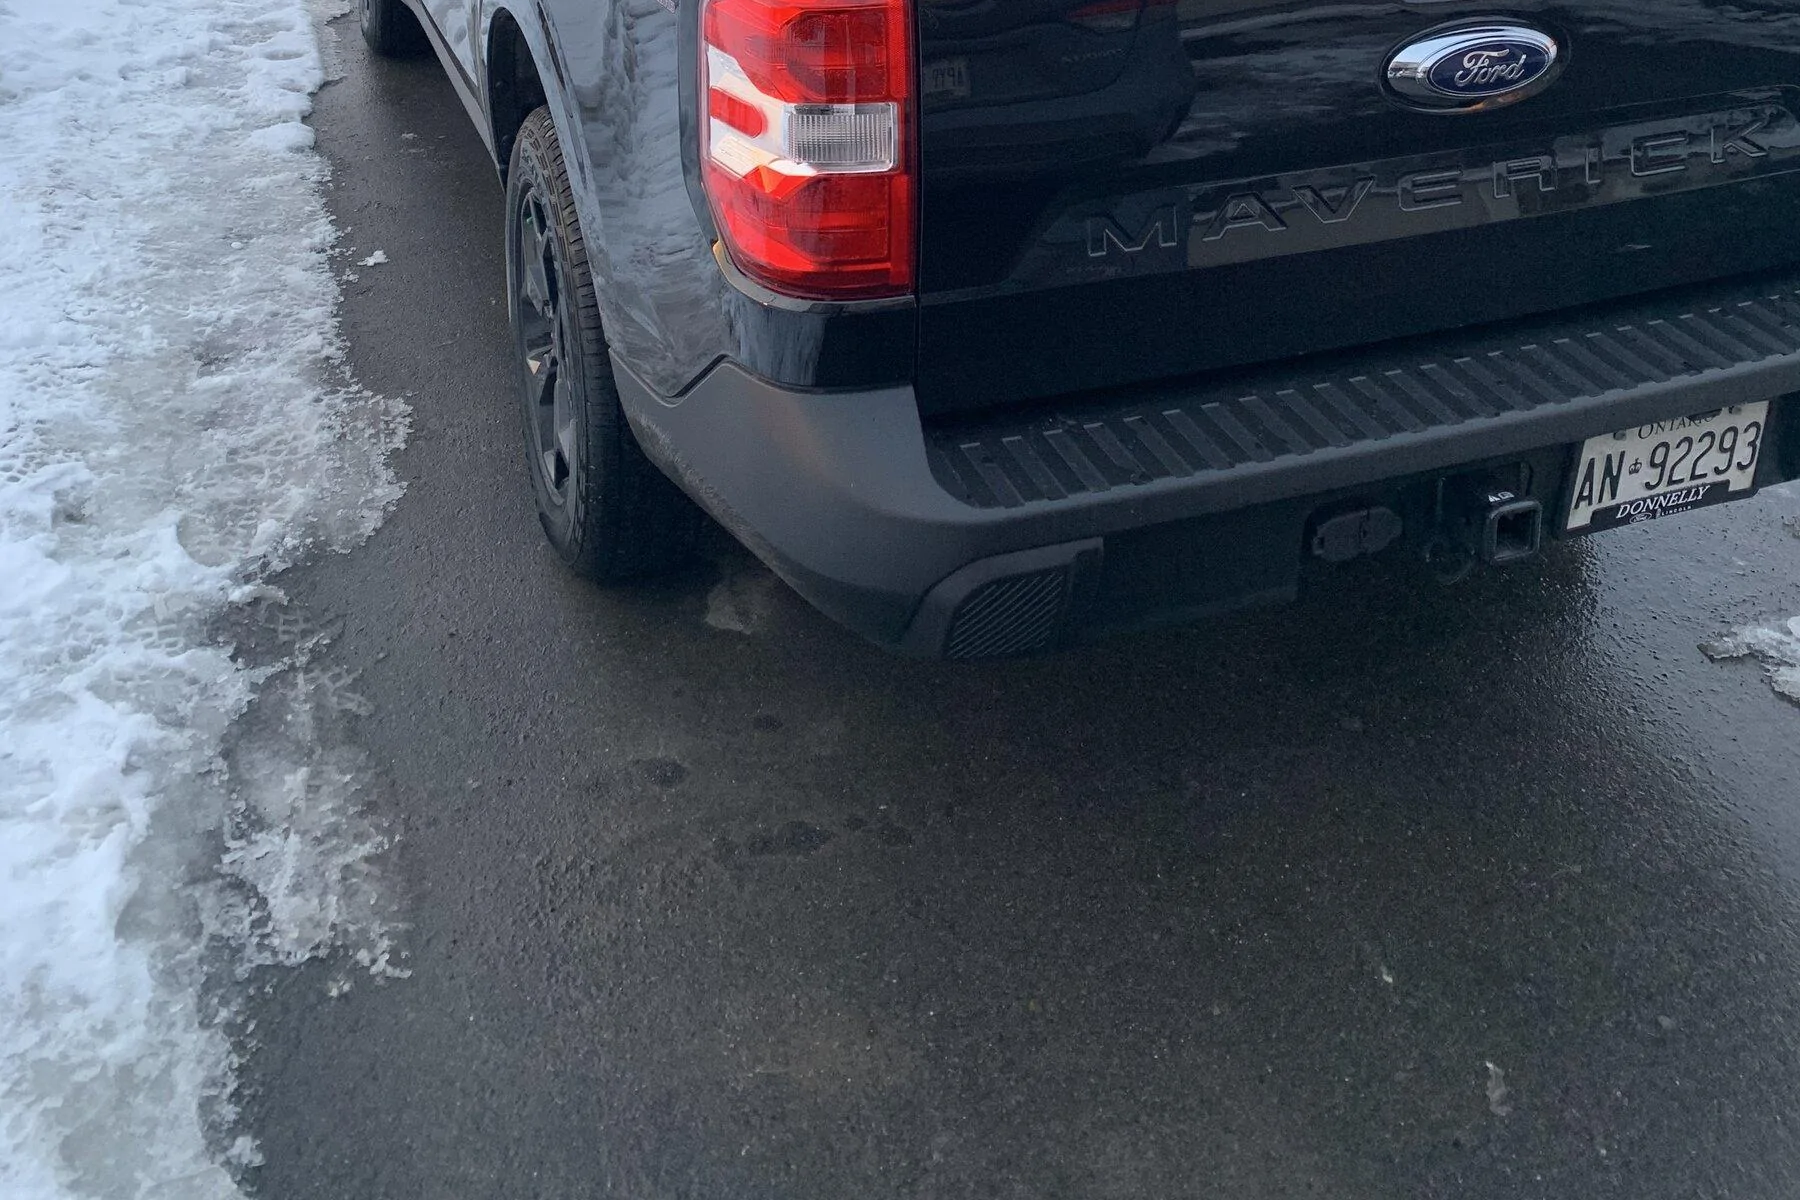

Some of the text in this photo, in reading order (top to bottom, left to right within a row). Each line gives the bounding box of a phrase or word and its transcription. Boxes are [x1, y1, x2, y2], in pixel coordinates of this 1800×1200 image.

[1454, 48, 1527, 87] Ford
[1088, 120, 1768, 257] MAVERICK
[1637, 416, 1713, 439] ONTAR
[1575, 420, 1762, 510] AN 92293
[1616, 485, 1710, 519] DONNELLY
